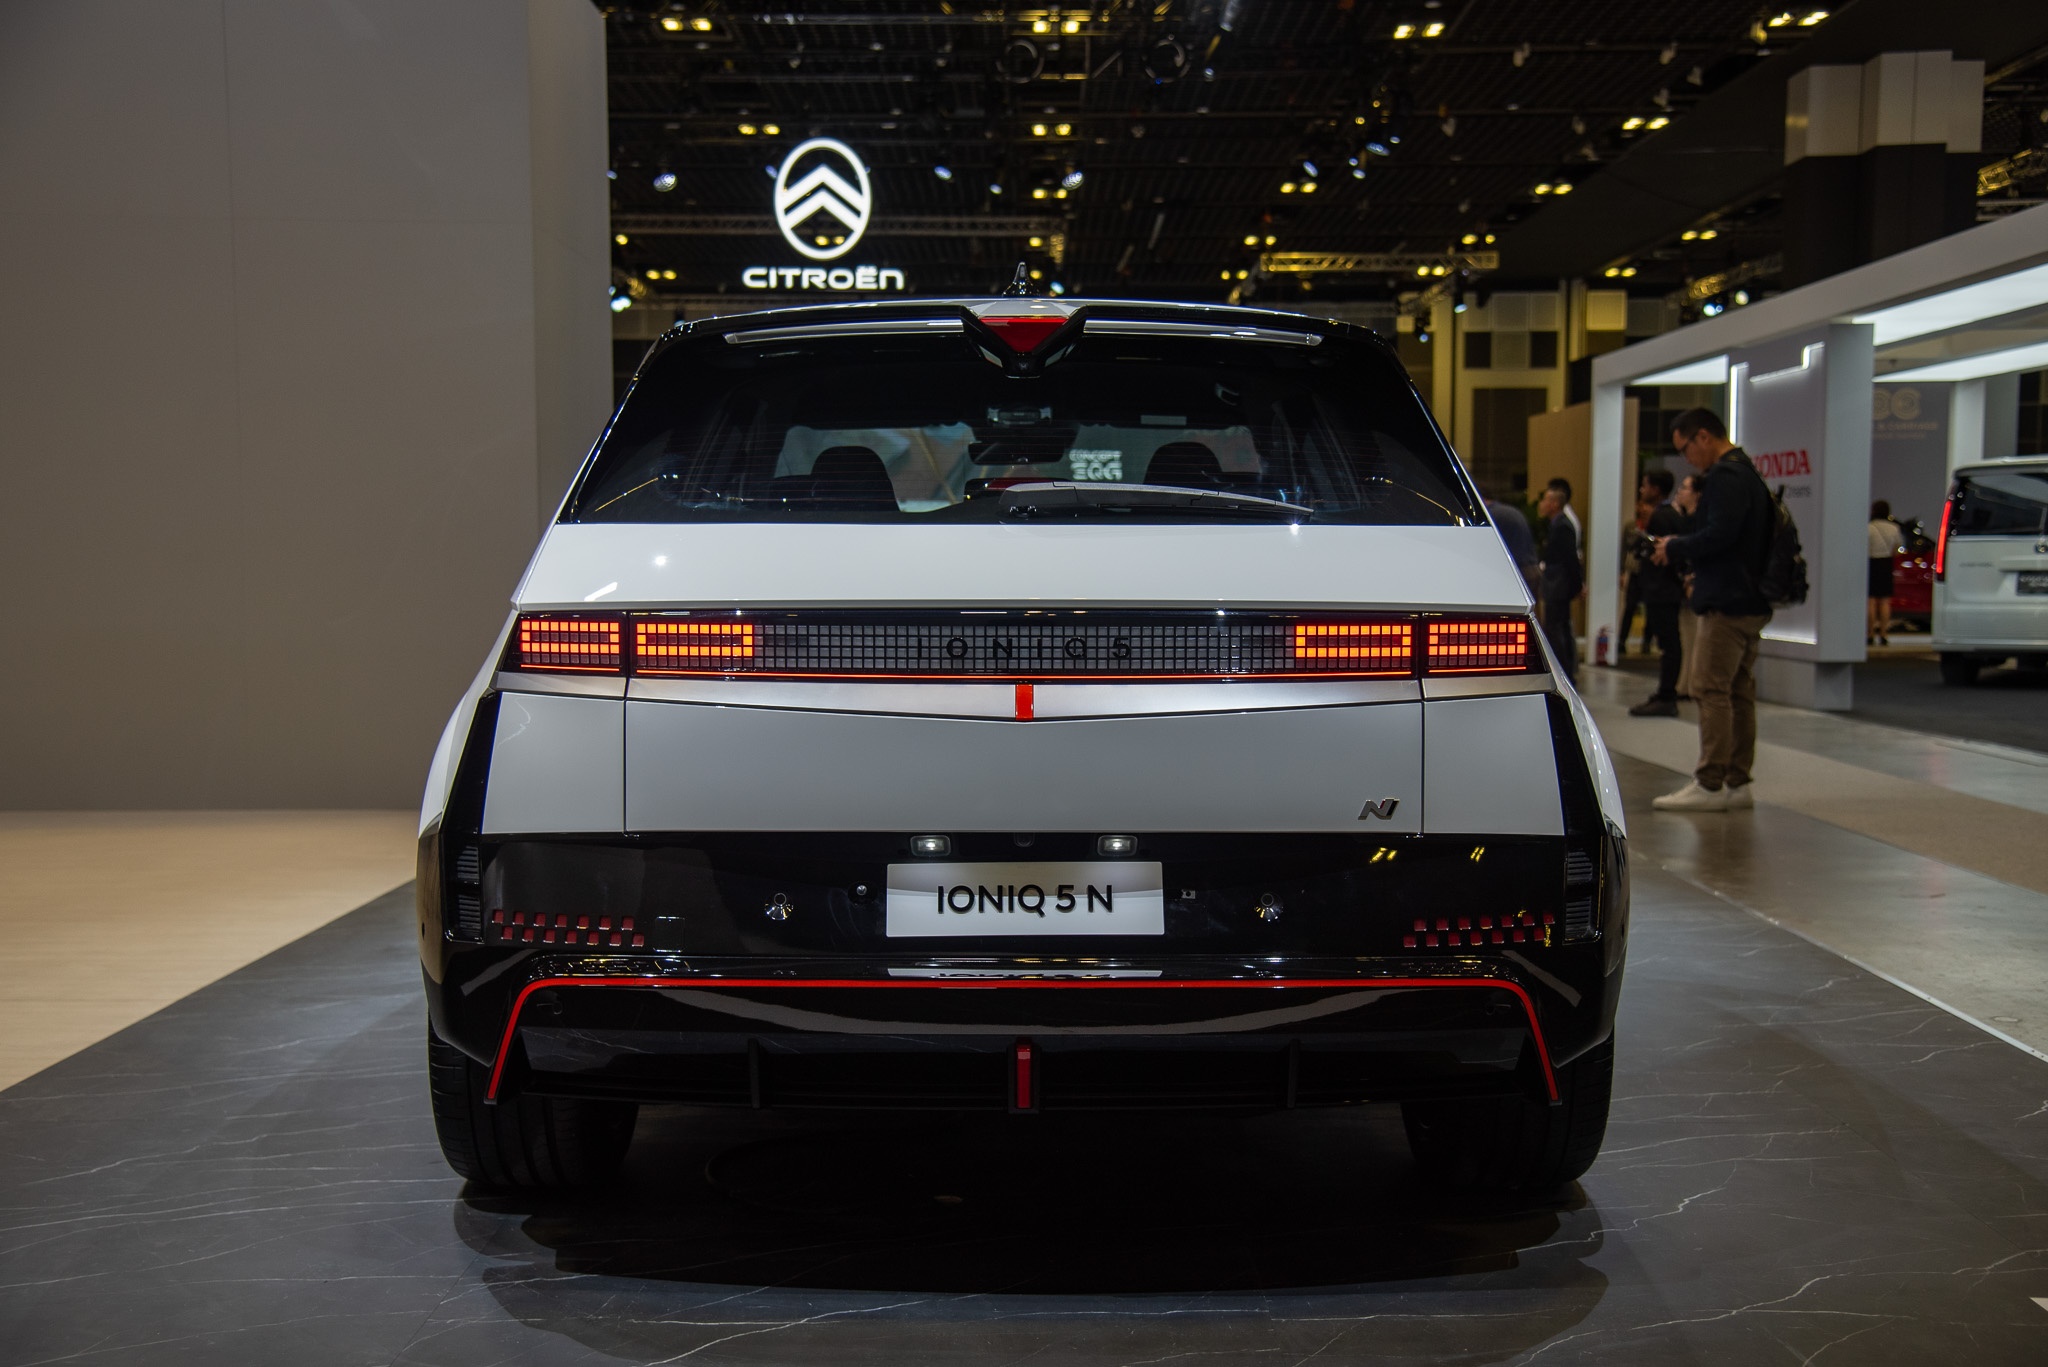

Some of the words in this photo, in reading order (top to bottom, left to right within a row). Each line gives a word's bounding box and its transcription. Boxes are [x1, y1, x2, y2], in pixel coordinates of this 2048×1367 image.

[1071, 461, 1122, 480] EQG
[917, 637, 1087, 659] IONIQ
[1112, 637, 1131, 659] 5
[937, 884, 1046, 918] IONIQ
[1055, 884, 1076, 913] 5
[1087, 884, 1113, 913] N
